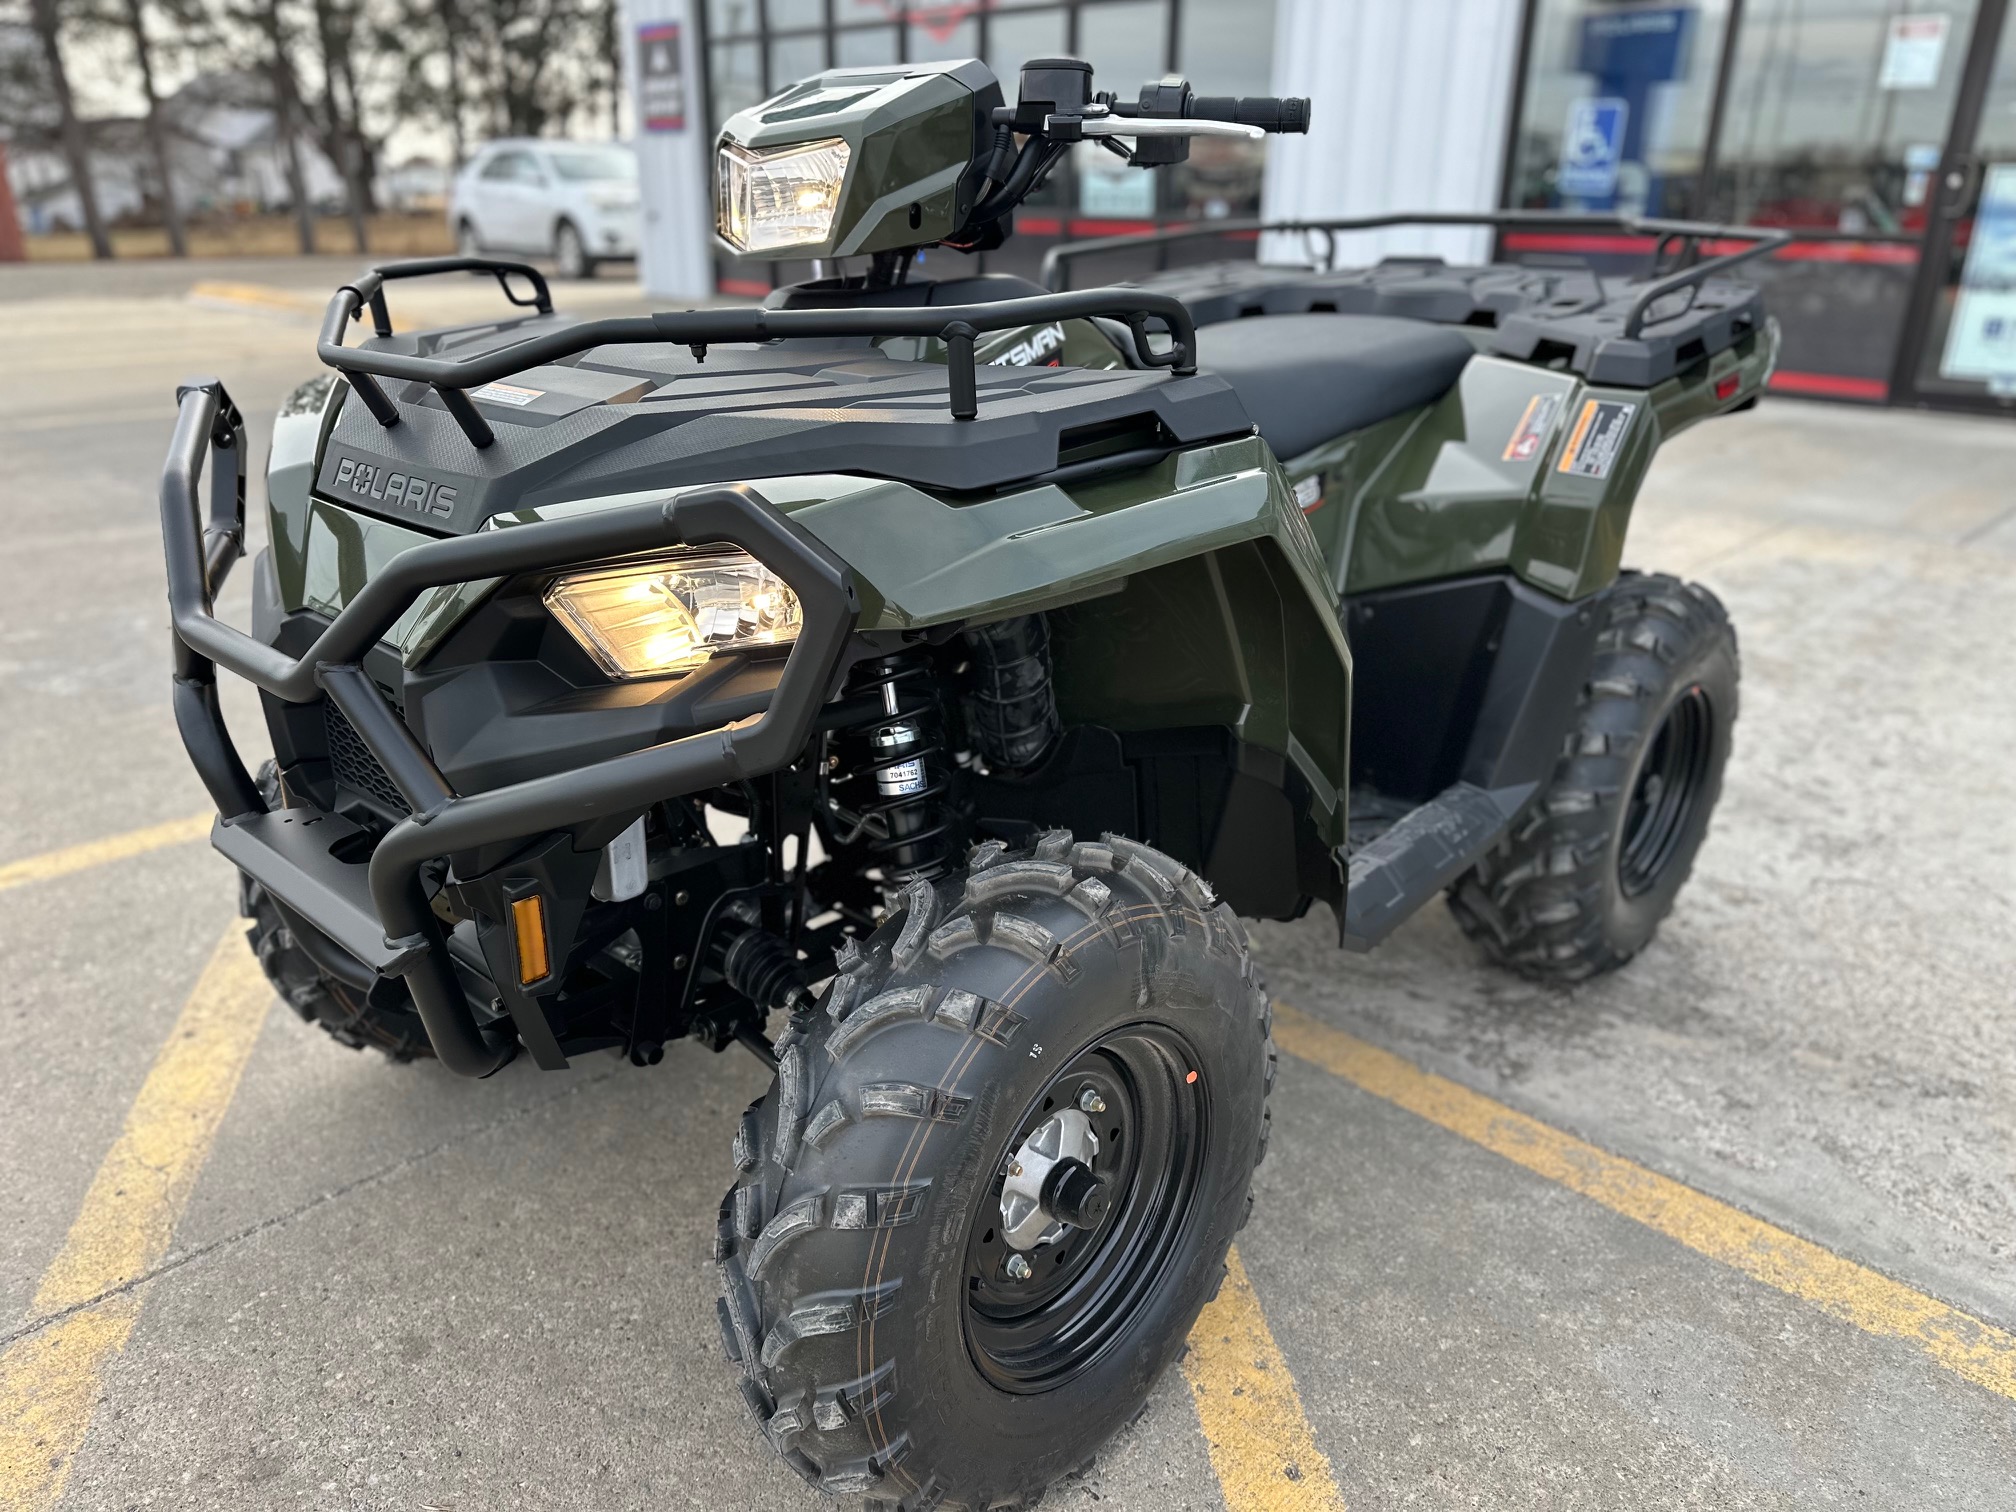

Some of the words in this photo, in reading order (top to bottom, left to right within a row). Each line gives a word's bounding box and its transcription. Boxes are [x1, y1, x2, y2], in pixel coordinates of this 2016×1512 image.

[988, 321, 1066, 367] TSMAN
[333, 457, 458, 520] POLARIS
[889, 768, 919, 779] 7041762
[898, 781, 925, 792] SACHS
